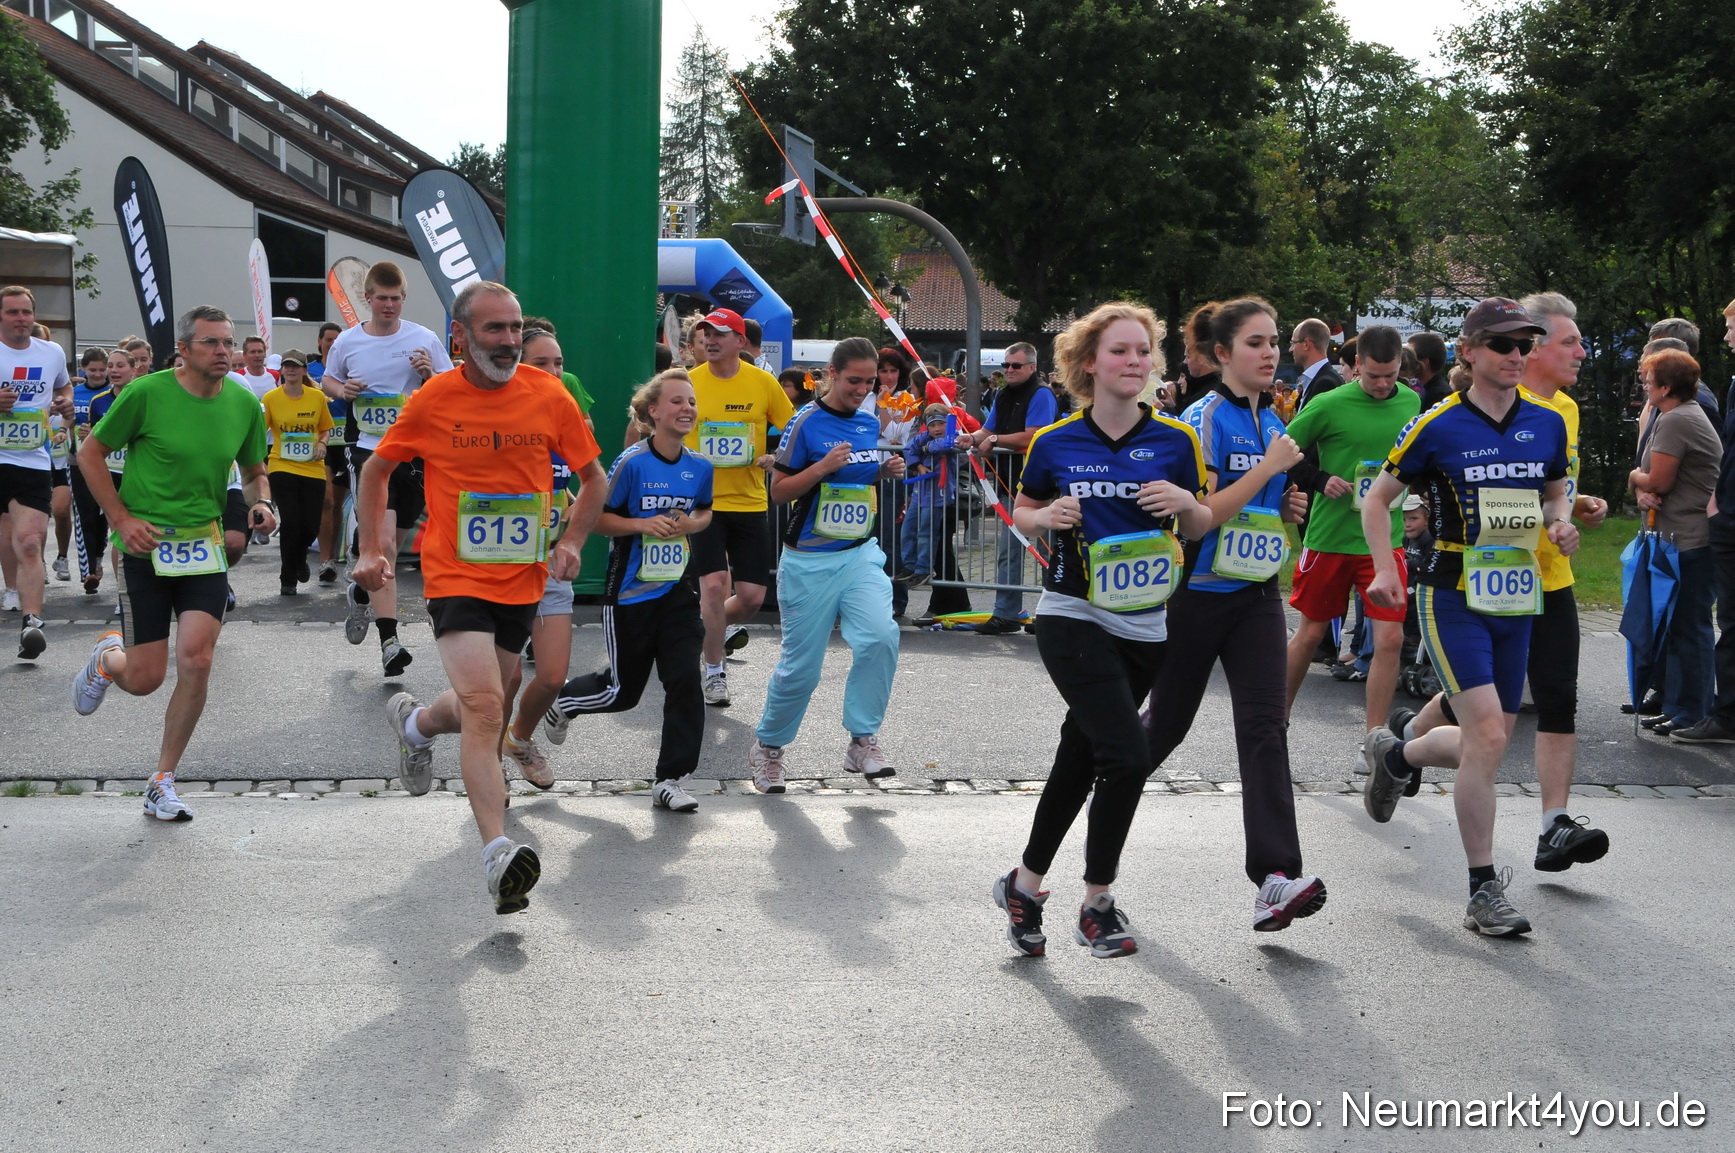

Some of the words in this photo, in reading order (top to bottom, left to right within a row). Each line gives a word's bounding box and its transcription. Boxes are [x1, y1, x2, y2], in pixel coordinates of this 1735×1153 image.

[361, 407, 398, 426] 483
[0, 422, 39, 439] 1261
[284, 442, 311, 456] 188
[452, 435, 490, 448] EURO
[504, 433, 544, 446] POLES
[705, 437, 743, 456] 182
[1232, 435, 1255, 447] TEAM
[847, 449, 881, 465] OCK
[1462, 447, 1499, 459] TEAM
[1068, 465, 1109, 473] TEAM
[1229, 453, 1264, 471] BO
[1463, 462, 1545, 483] BOCK
[1069, 481, 1147, 499] BOC
[641, 495, 694, 511] BOCK
[1485, 500, 1535, 509] sponsored
[821, 503, 868, 525] 1089
[1487, 515, 1537, 530] WGG
[467, 515, 529, 545] 613
[158, 539, 209, 564] 855
[642, 544, 683, 566] 1088
[1223, 530, 1283, 563] 1083
[1232, 559, 1249, 569] Rina
[1095, 557, 1170, 593] 1082
[1469, 568, 1534, 596] 1069
[1478, 598, 1499, 606] Franz
